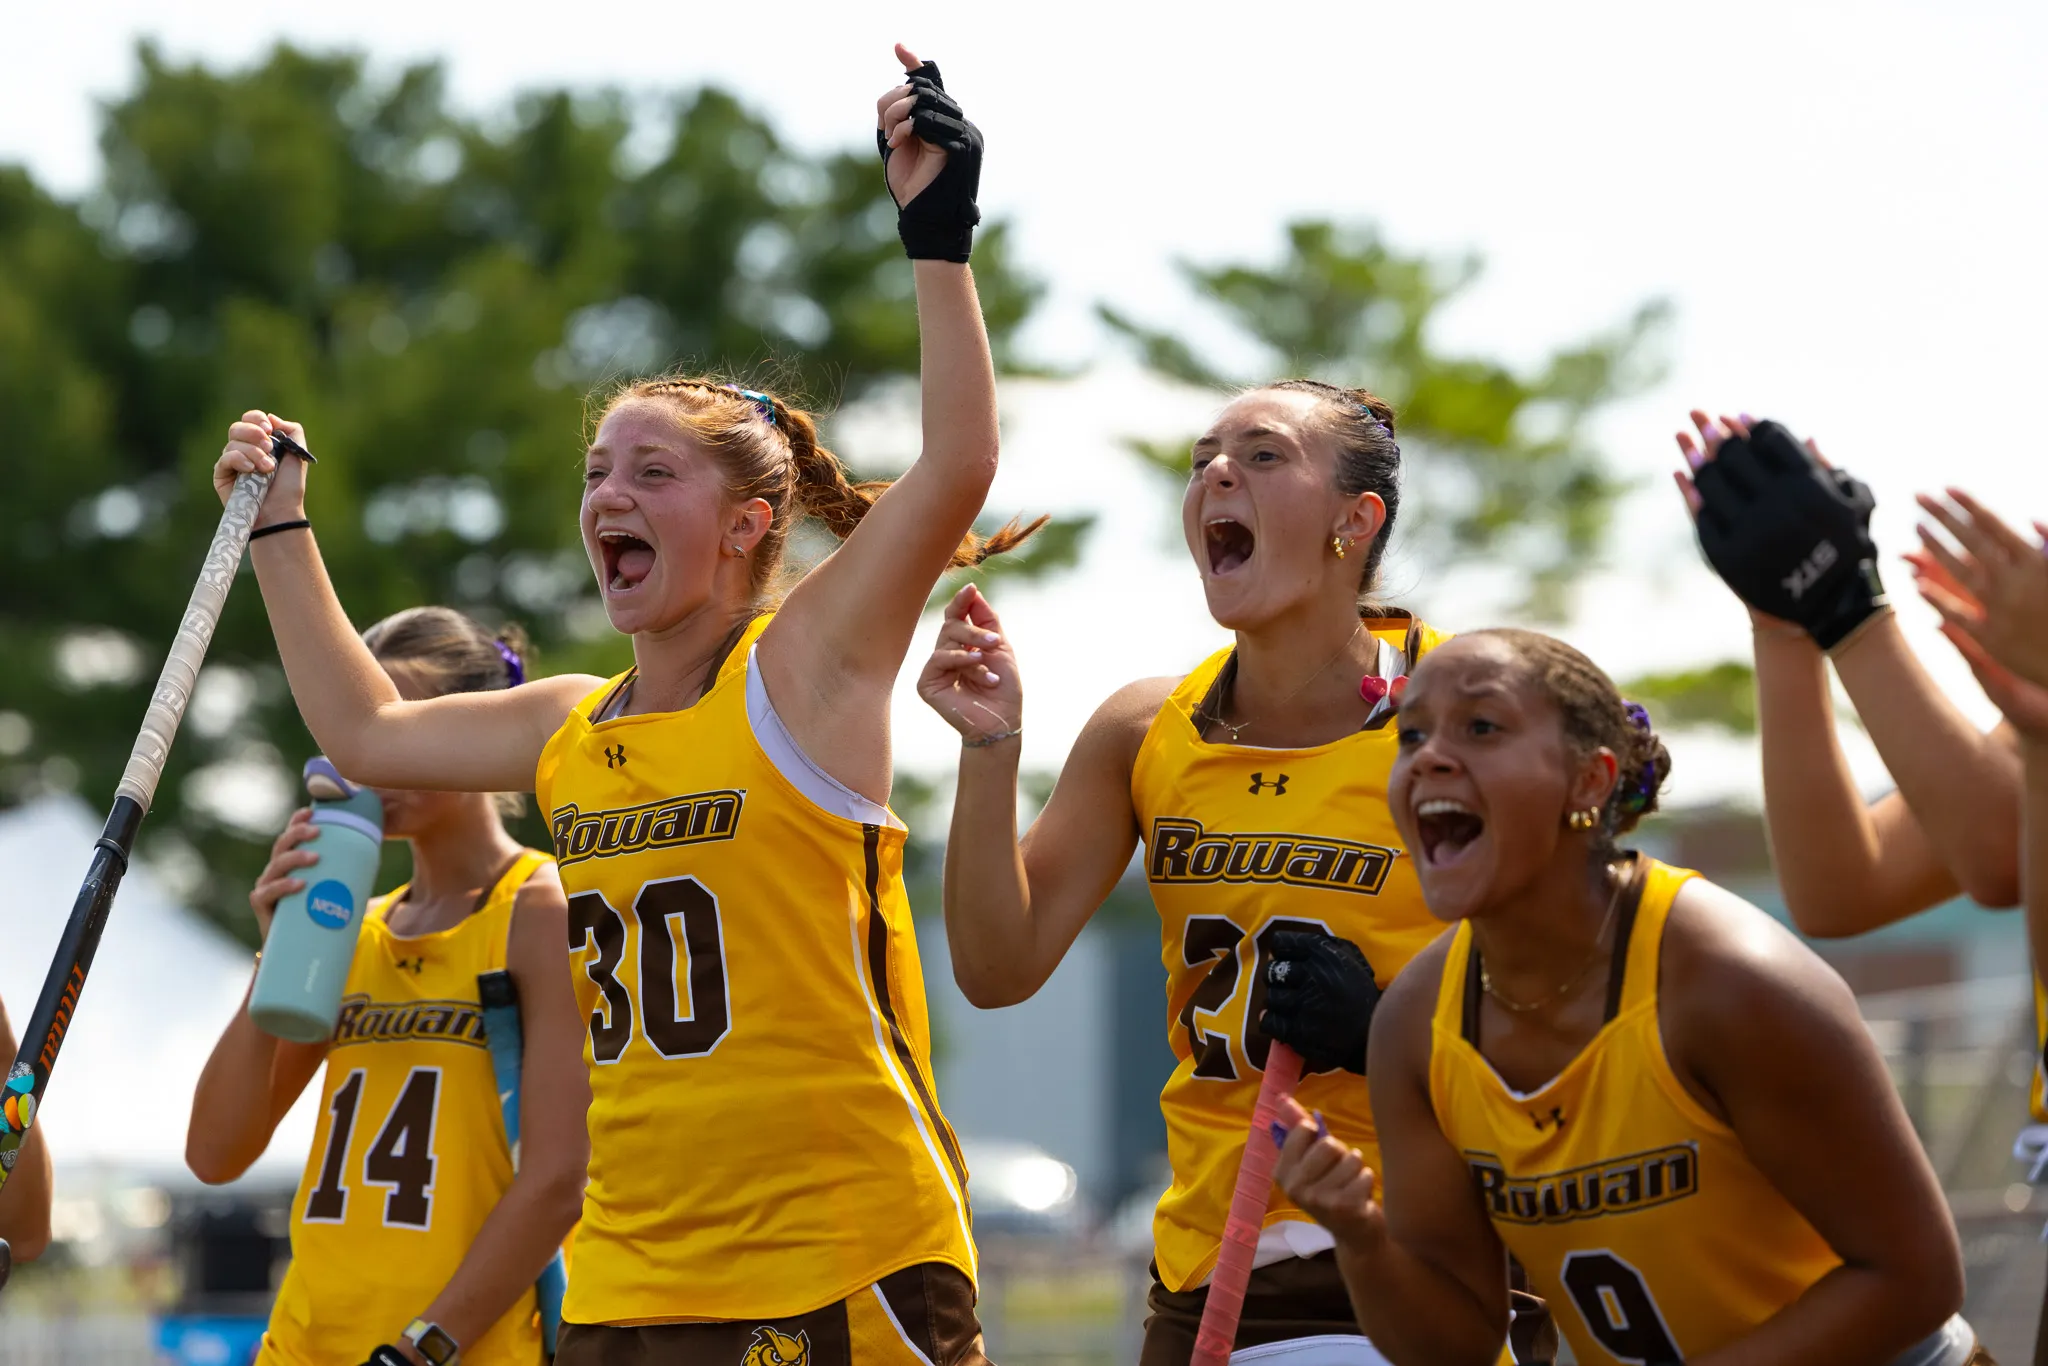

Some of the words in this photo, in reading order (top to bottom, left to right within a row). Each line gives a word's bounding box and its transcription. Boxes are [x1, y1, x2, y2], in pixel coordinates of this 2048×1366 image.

[553, 797, 737, 864] Rowan
[1152, 825, 1387, 889] Rowan
[568, 875, 732, 1065] 30
[334, 1000, 487, 1042] Rowan
[304, 1066, 443, 1231] 14
[1468, 1152, 1690, 1218] Rowan
